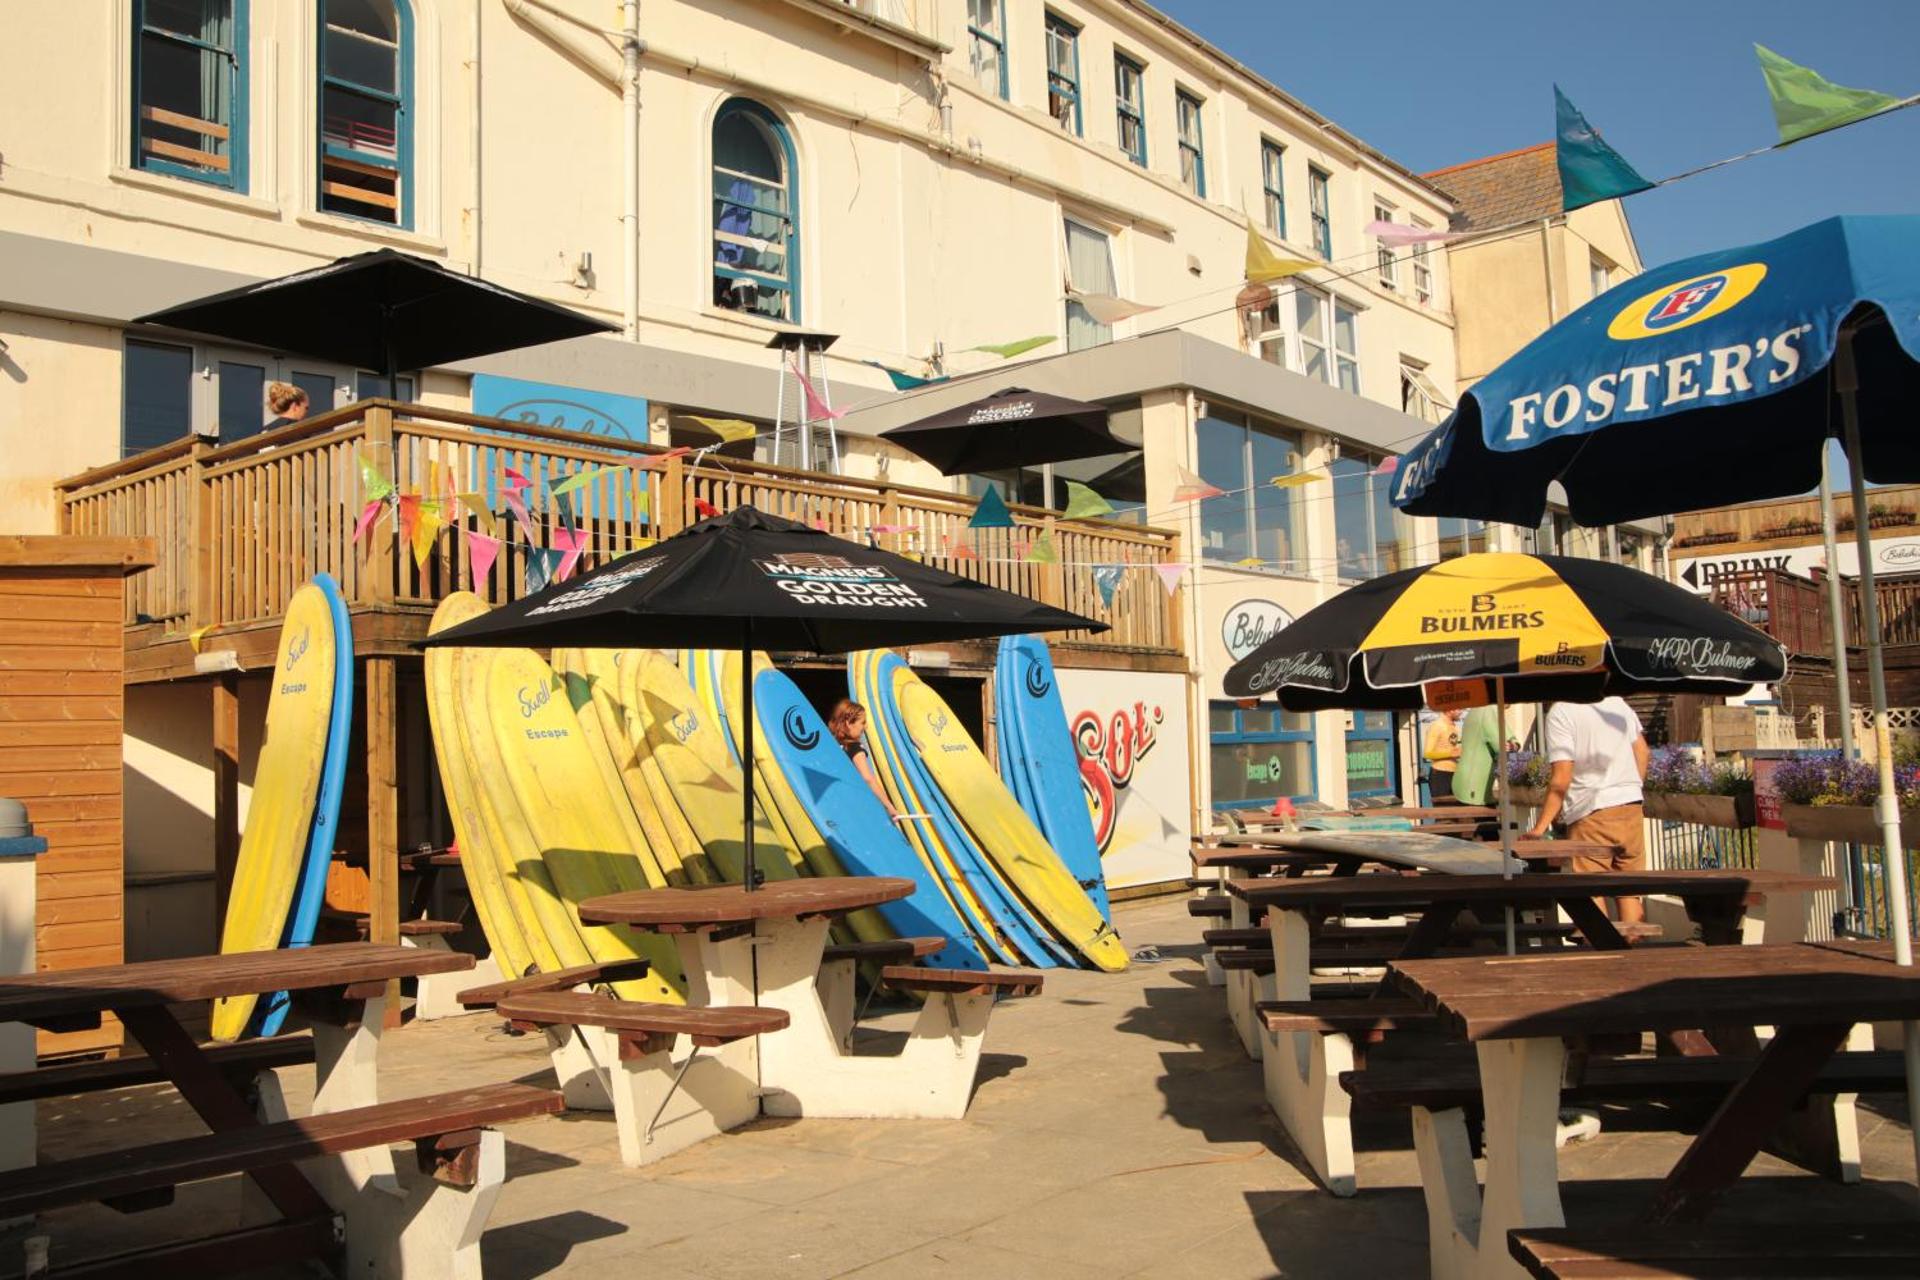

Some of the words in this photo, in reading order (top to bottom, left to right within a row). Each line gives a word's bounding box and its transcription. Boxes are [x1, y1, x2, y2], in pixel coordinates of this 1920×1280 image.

[1506, 325, 1806, 440] FOSTER'S
[763, 561, 885, 578] MAGNERS
[777, 579, 918, 597] GOLDEN
[790, 593, 928, 608] DRAUGHT
[1420, 611, 1545, 634] BULMERS
[1535, 654, 1587, 667] BULMERS
[517, 677, 550, 718] Swell
[526, 728, 569, 740] Escape
